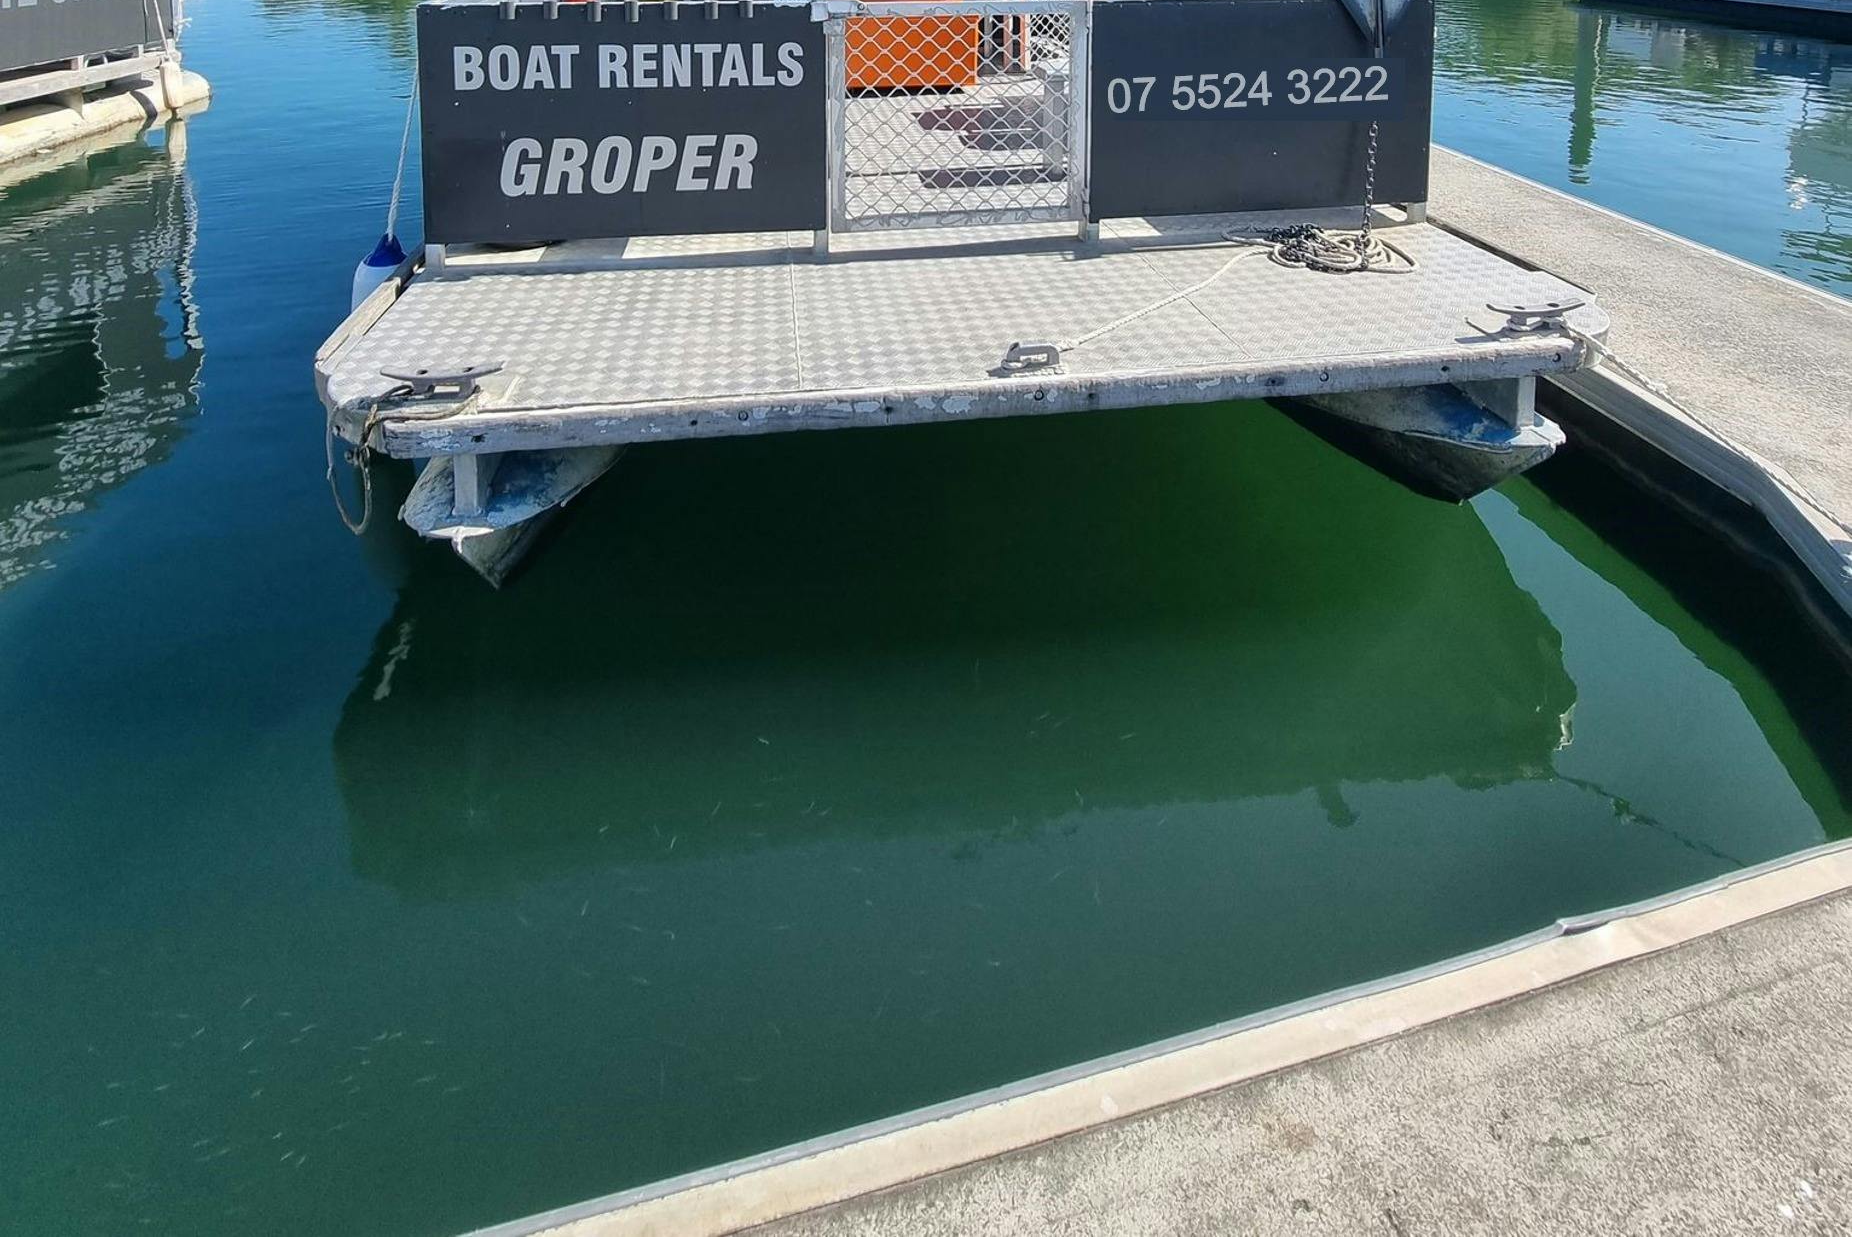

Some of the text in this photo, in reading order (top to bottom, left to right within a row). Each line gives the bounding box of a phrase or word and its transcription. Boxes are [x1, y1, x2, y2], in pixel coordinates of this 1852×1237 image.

[452, 41, 804, 91] BOAT RENTALS
[1106, 65, 1389, 114] 07 5524 3222
[500, 133, 758, 197] GROPER
